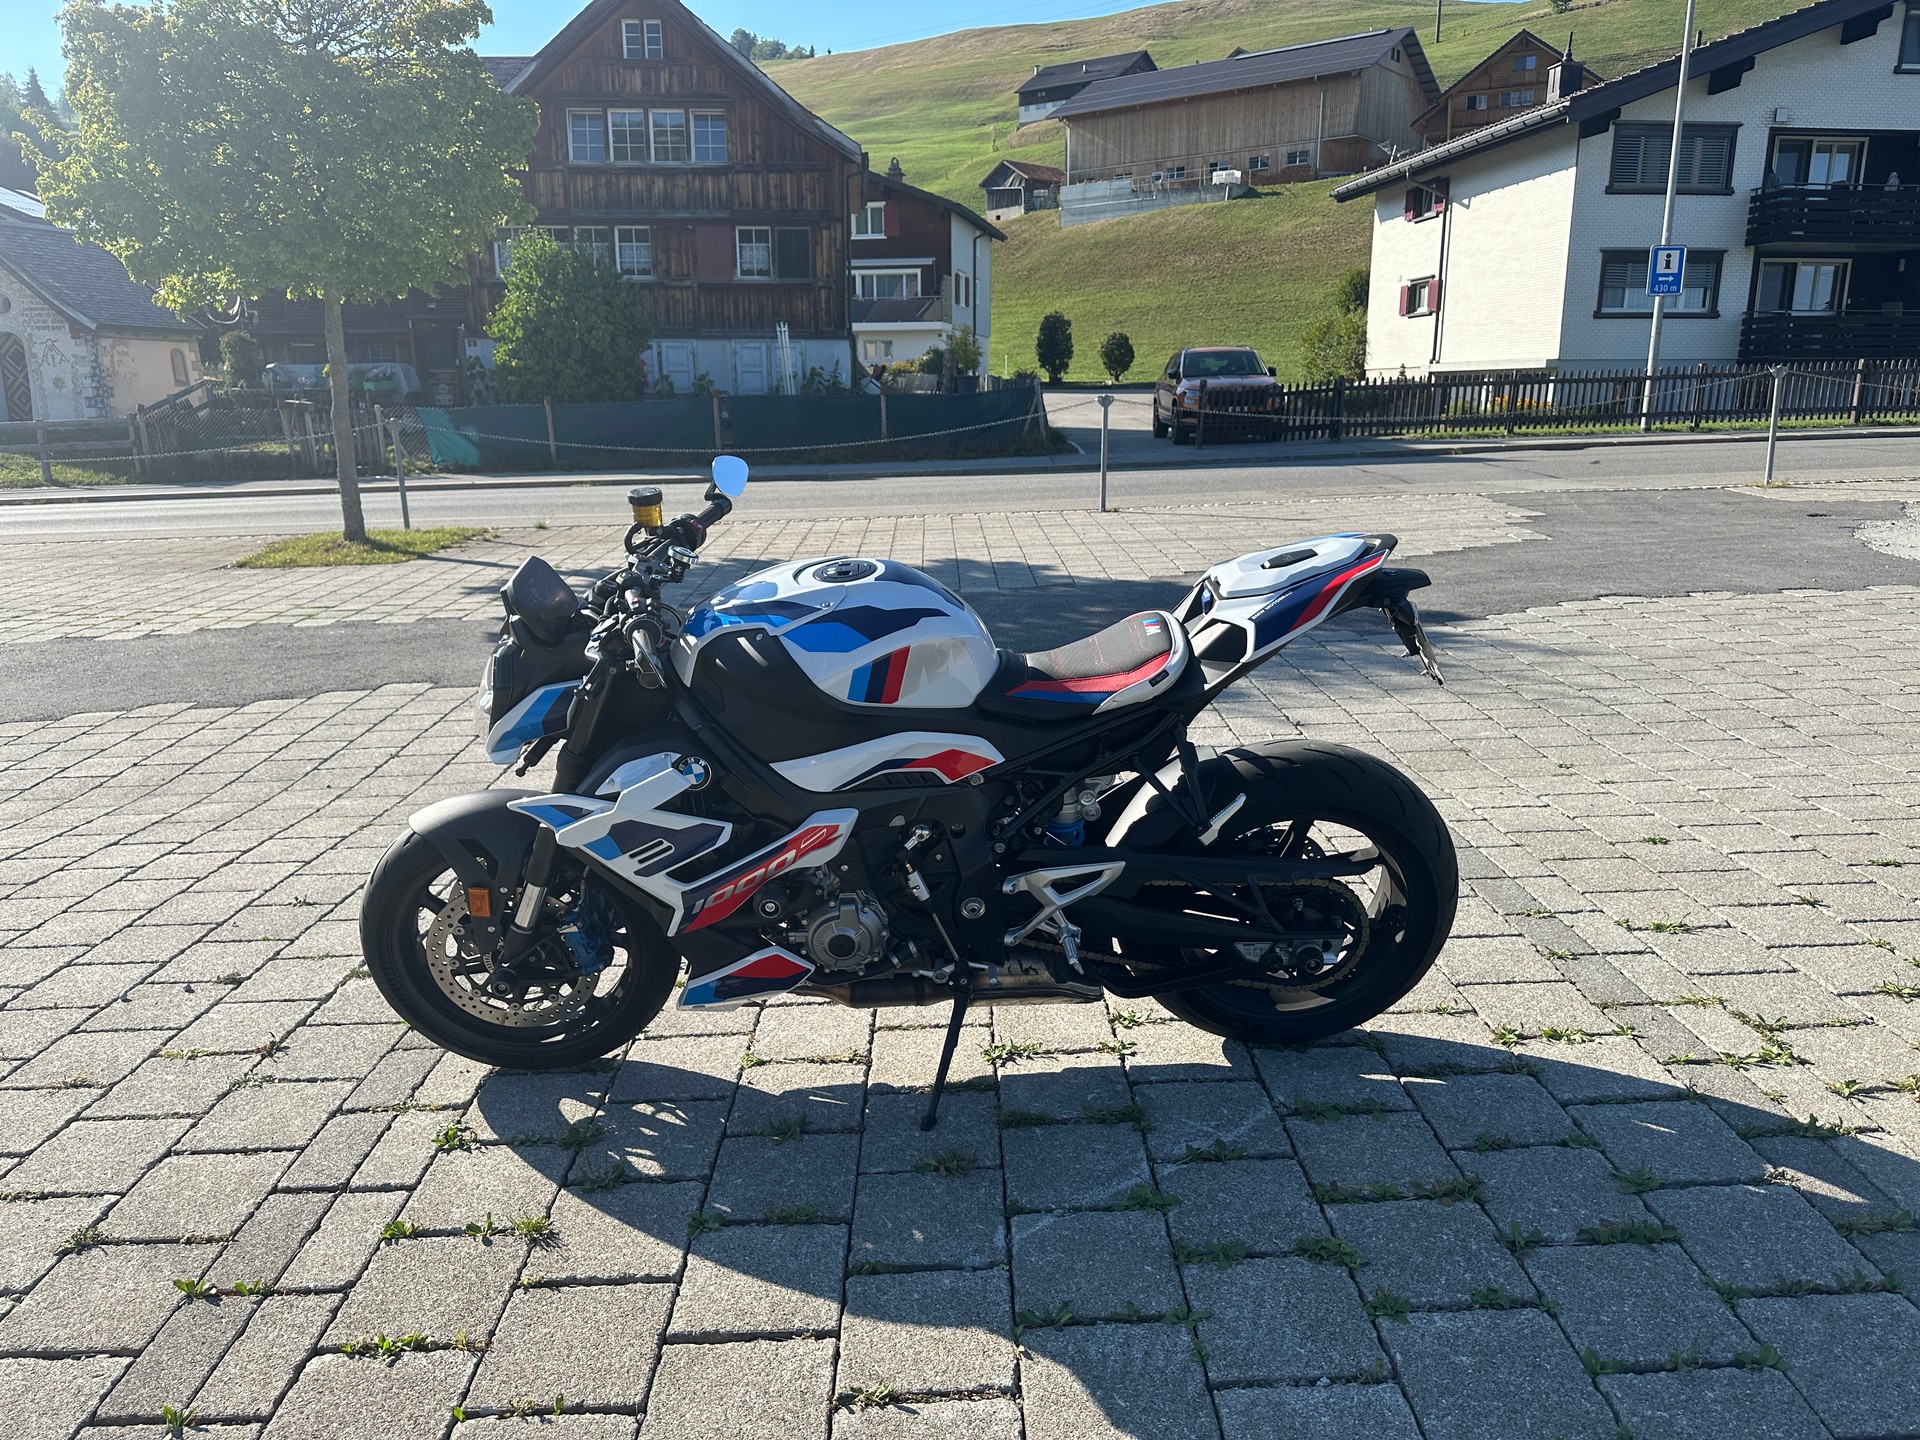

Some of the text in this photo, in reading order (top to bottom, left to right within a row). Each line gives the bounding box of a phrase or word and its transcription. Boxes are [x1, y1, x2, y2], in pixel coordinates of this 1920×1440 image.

[1653, 284, 1668, 292] 430
[1251, 609, 1265, 620] BMW
[679, 757, 706, 771] BMW
